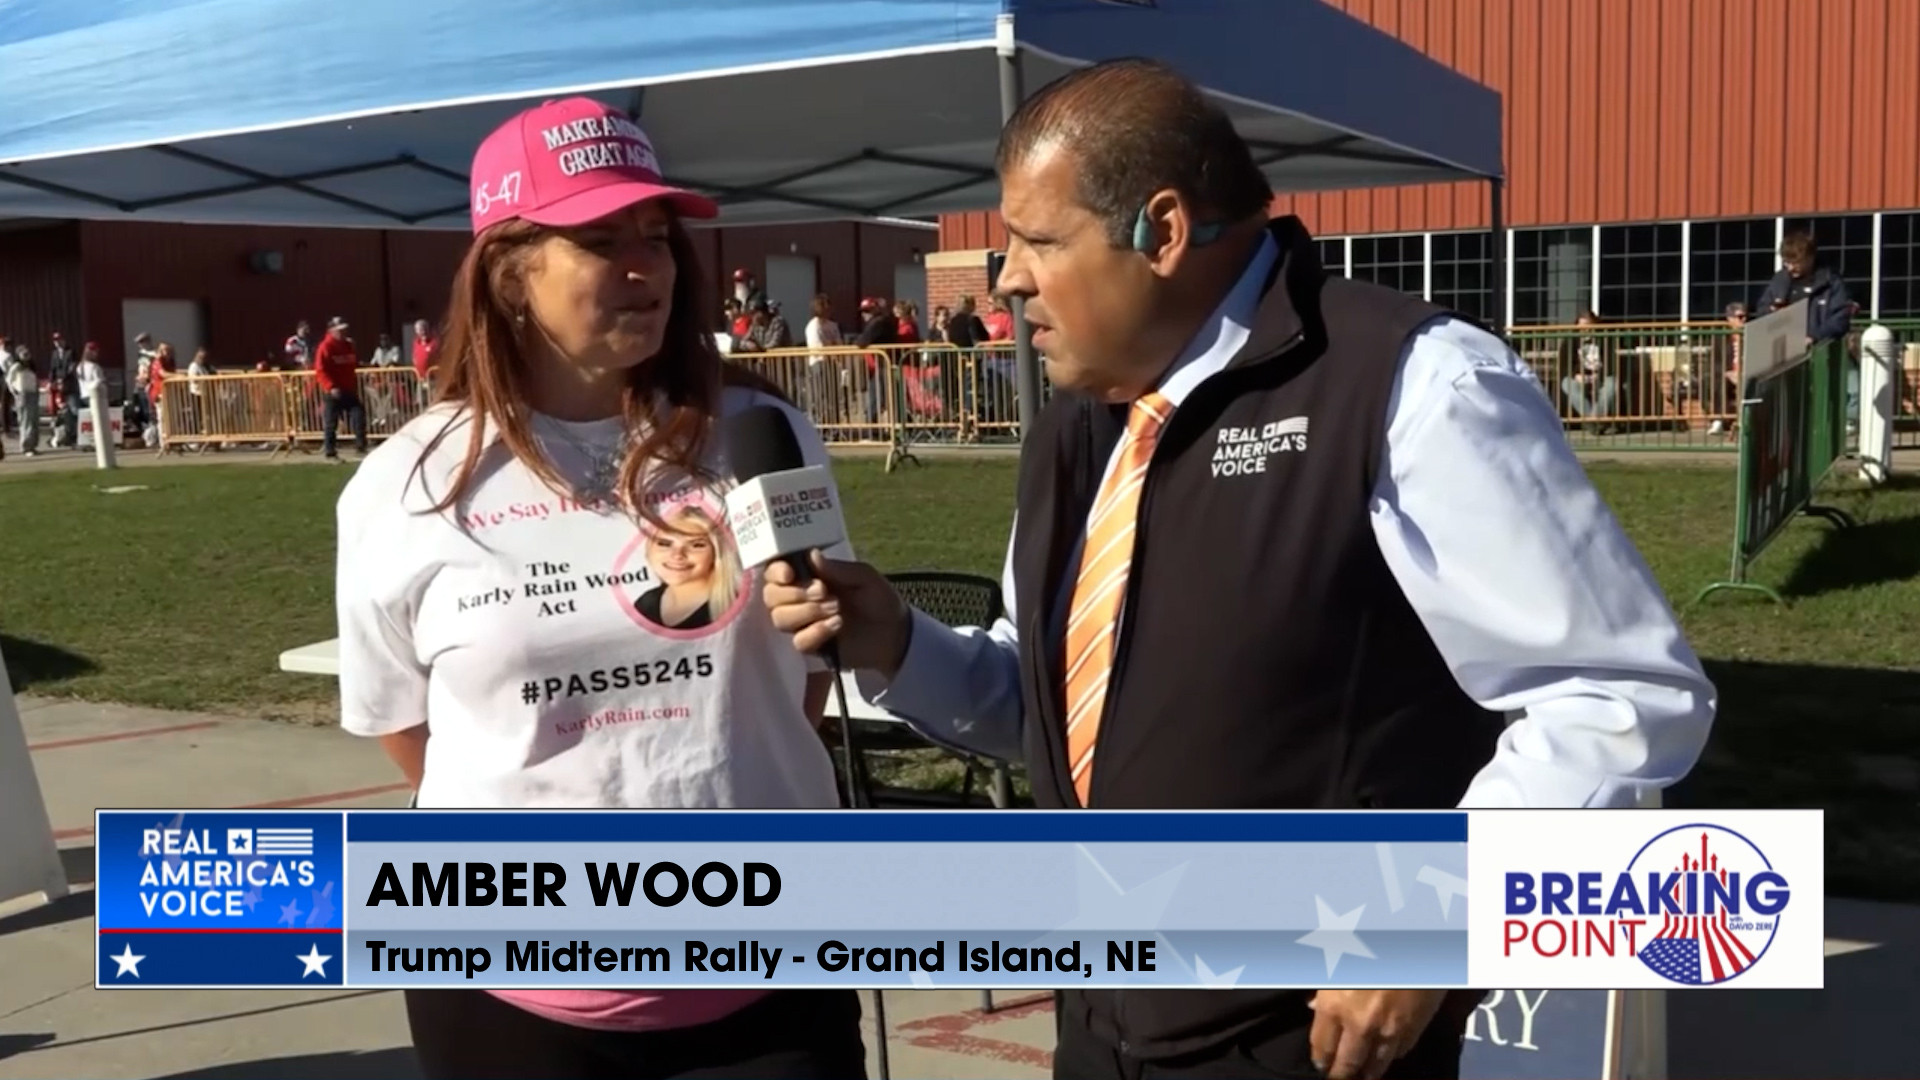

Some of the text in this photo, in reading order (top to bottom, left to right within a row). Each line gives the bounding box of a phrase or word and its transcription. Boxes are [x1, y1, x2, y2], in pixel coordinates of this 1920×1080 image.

[542, 116, 602, 151] MAKE
[559, 142, 625, 176] GREAT
[1212, 434, 1307, 461] AMERICA'S
[1217, 427, 1259, 444] REAL
[1211, 456, 1267, 478] VOICE
[461, 509, 504, 531] We
[509, 500, 551, 520] Say
[775, 514, 813, 528] VOICE
[526, 561, 571, 577] The
[457, 566, 649, 612] Karly Rain Wood
[537, 599, 577, 617] Act
[521, 654, 713, 704] #PASS5245
[555, 705, 691, 736] KarlyRain.com
